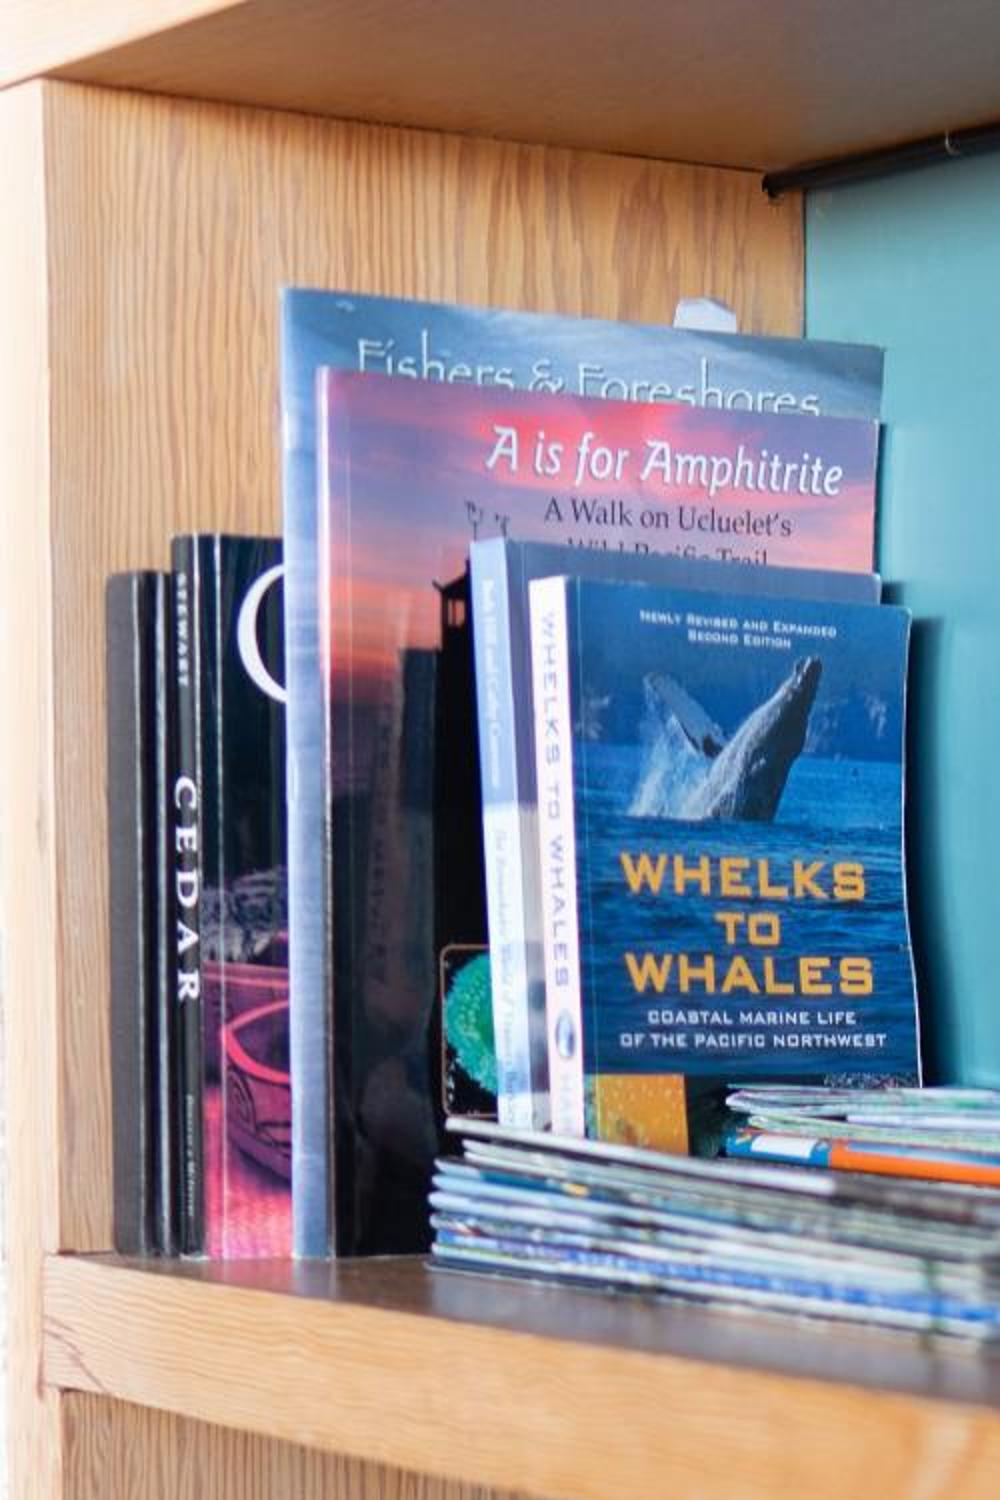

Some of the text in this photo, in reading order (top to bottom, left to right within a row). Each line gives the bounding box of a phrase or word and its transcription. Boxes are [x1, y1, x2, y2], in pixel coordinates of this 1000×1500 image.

[357, 329, 821, 417] Fishers & Foreshores
[485, 424, 844, 497] A is for Amphitrite
[544, 497, 792, 537] A Walk on Ucluelet's
[687, 628, 792, 650] SECOND EDITION
[542, 612, 569, 988] WHELKS TO WHALES
[174, 775, 200, 1001] CEDAR
[620, 851, 866, 901] WHELKS
[714, 911, 781, 946] TO
[624, 952, 873, 996] WHALES
[647, 1009, 856, 1025] COASTAL MARINE LIFE
[619, 1032, 887, 1048] OF THE PACIFIC NORTHWEST
